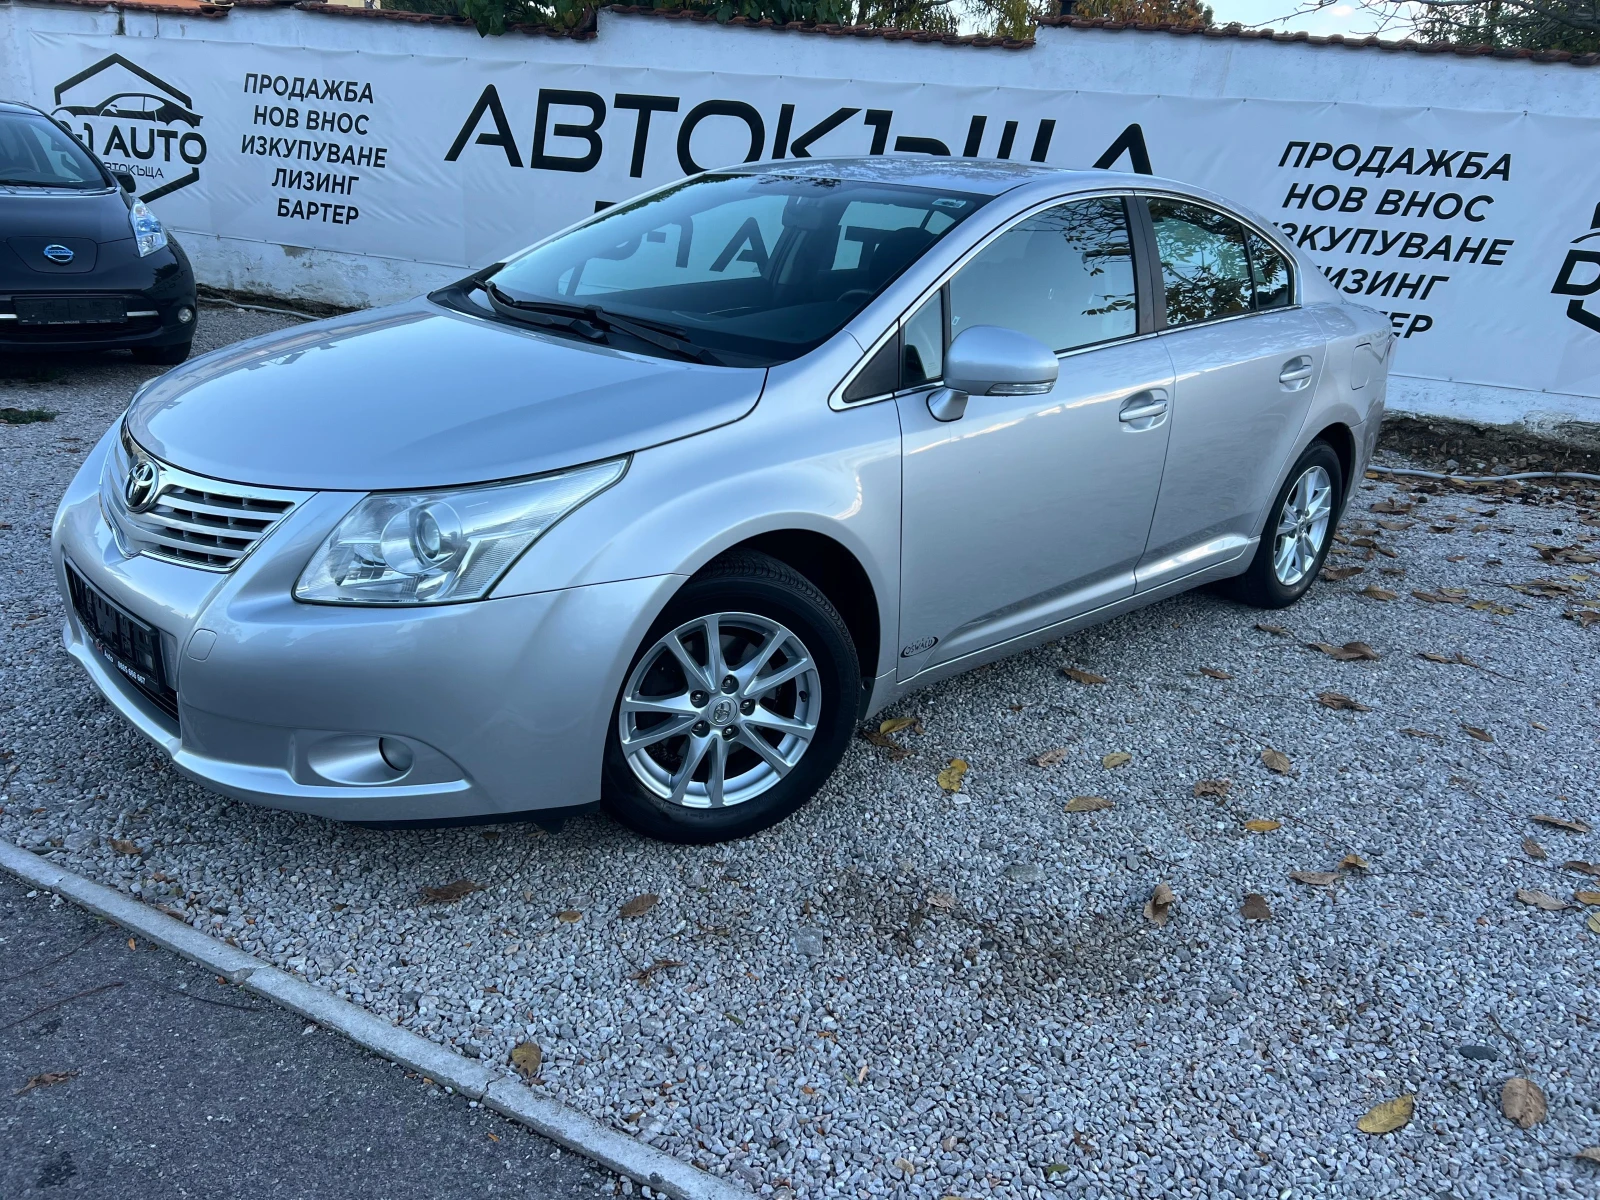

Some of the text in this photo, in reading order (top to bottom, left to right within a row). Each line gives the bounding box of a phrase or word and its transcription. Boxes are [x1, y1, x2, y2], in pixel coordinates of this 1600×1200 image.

[243, 73, 374, 104] ПРОДАЖБА
[253, 104, 370, 136] НОВ ВНОС
[102, 124, 207, 166] AUTO
[241, 134, 388, 169] ИЗКУПУВАНЕ
[1277, 141, 1512, 182] ПРОДАЖБА
[104, 161, 165, 180] ВТОКЪЩА
[271, 167, 360, 196] ЛИЗИНГ
[277, 197, 359, 225] БАРТЕР
[1281, 182, 1495, 223] НОВ ВНОС
[1273, 222, 1515, 266] ЗКУПУВАНЕ
[1317, 265, 1450, 301] ИЗИНГ
